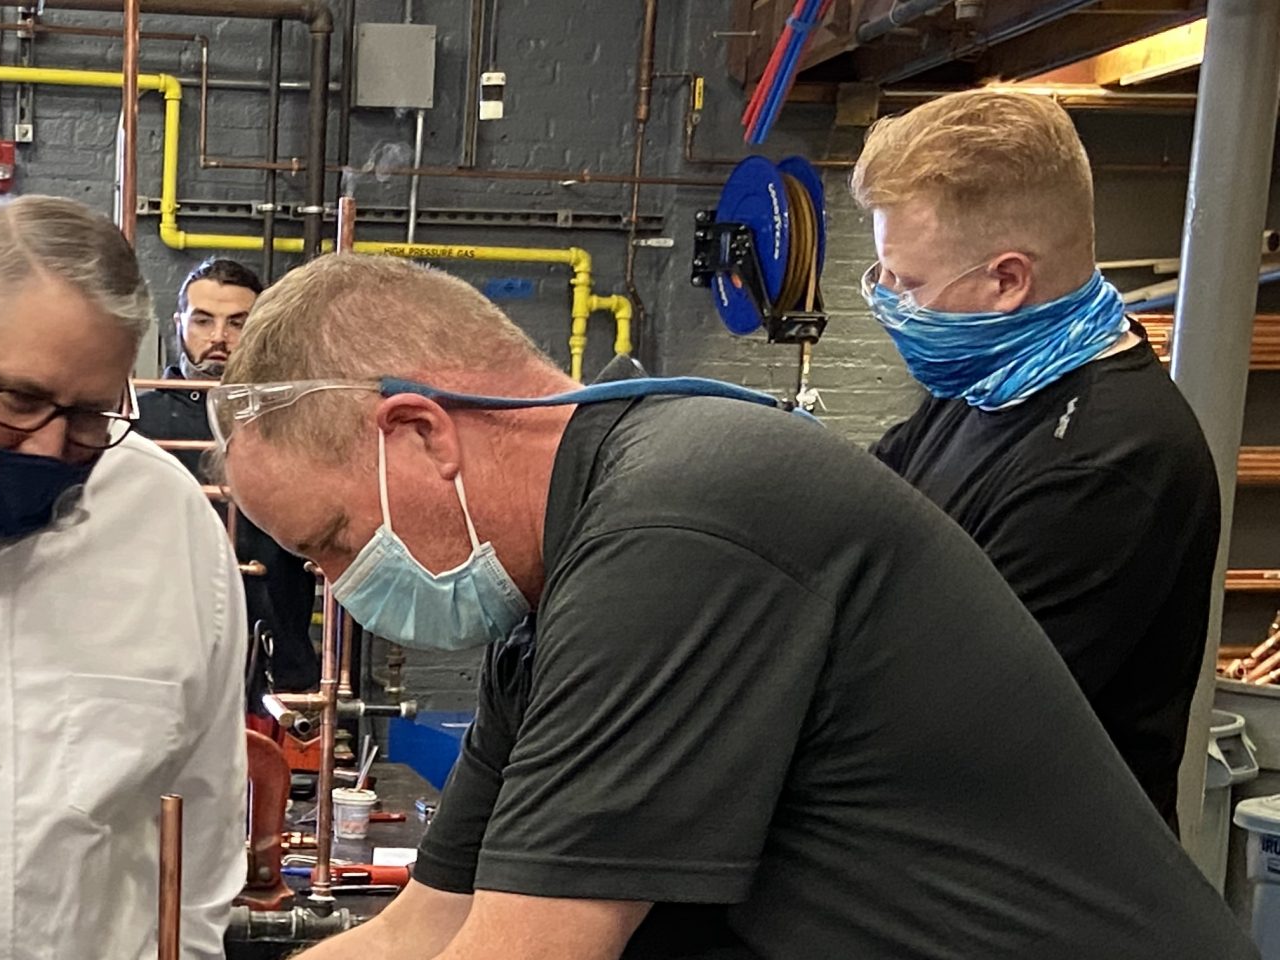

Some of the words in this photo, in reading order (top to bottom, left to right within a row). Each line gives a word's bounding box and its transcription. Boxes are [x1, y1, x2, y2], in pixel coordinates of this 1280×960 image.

[384, 247, 405, 256] HIGH
[409, 247, 453, 257] PRESSURE
[457, 249, 476, 258] GAS
